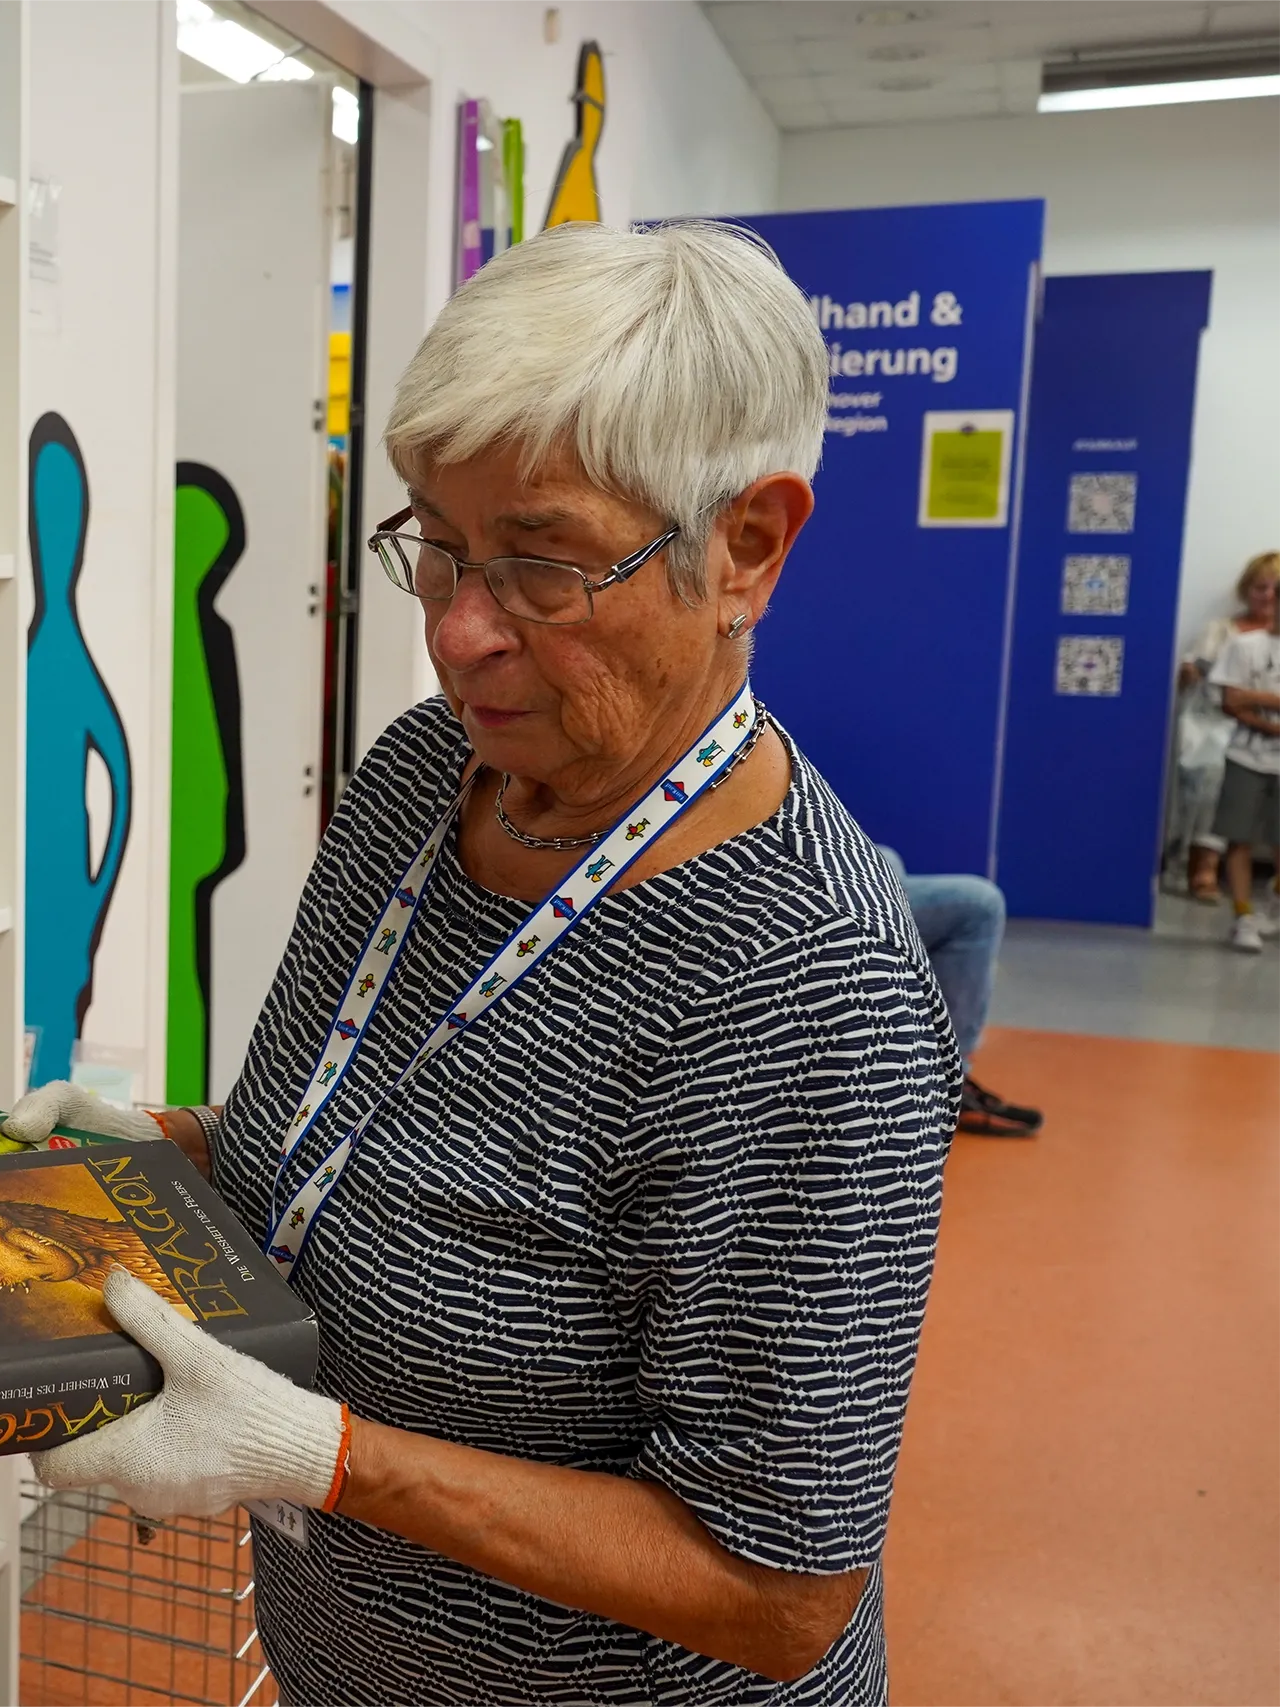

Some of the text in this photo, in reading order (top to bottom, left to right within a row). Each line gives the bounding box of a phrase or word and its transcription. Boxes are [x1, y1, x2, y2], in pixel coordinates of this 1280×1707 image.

[930, 290, 963, 326] &
[87, 1154, 250, 1322] ERAGON
[170, 1180, 256, 1283] DIE WEISHEIT DES FEUERS
[36, 1383, 56, 1395] DES
[58, 1376, 109, 1393] WEISHEIT
[112, 1373, 131, 1387] DIE
